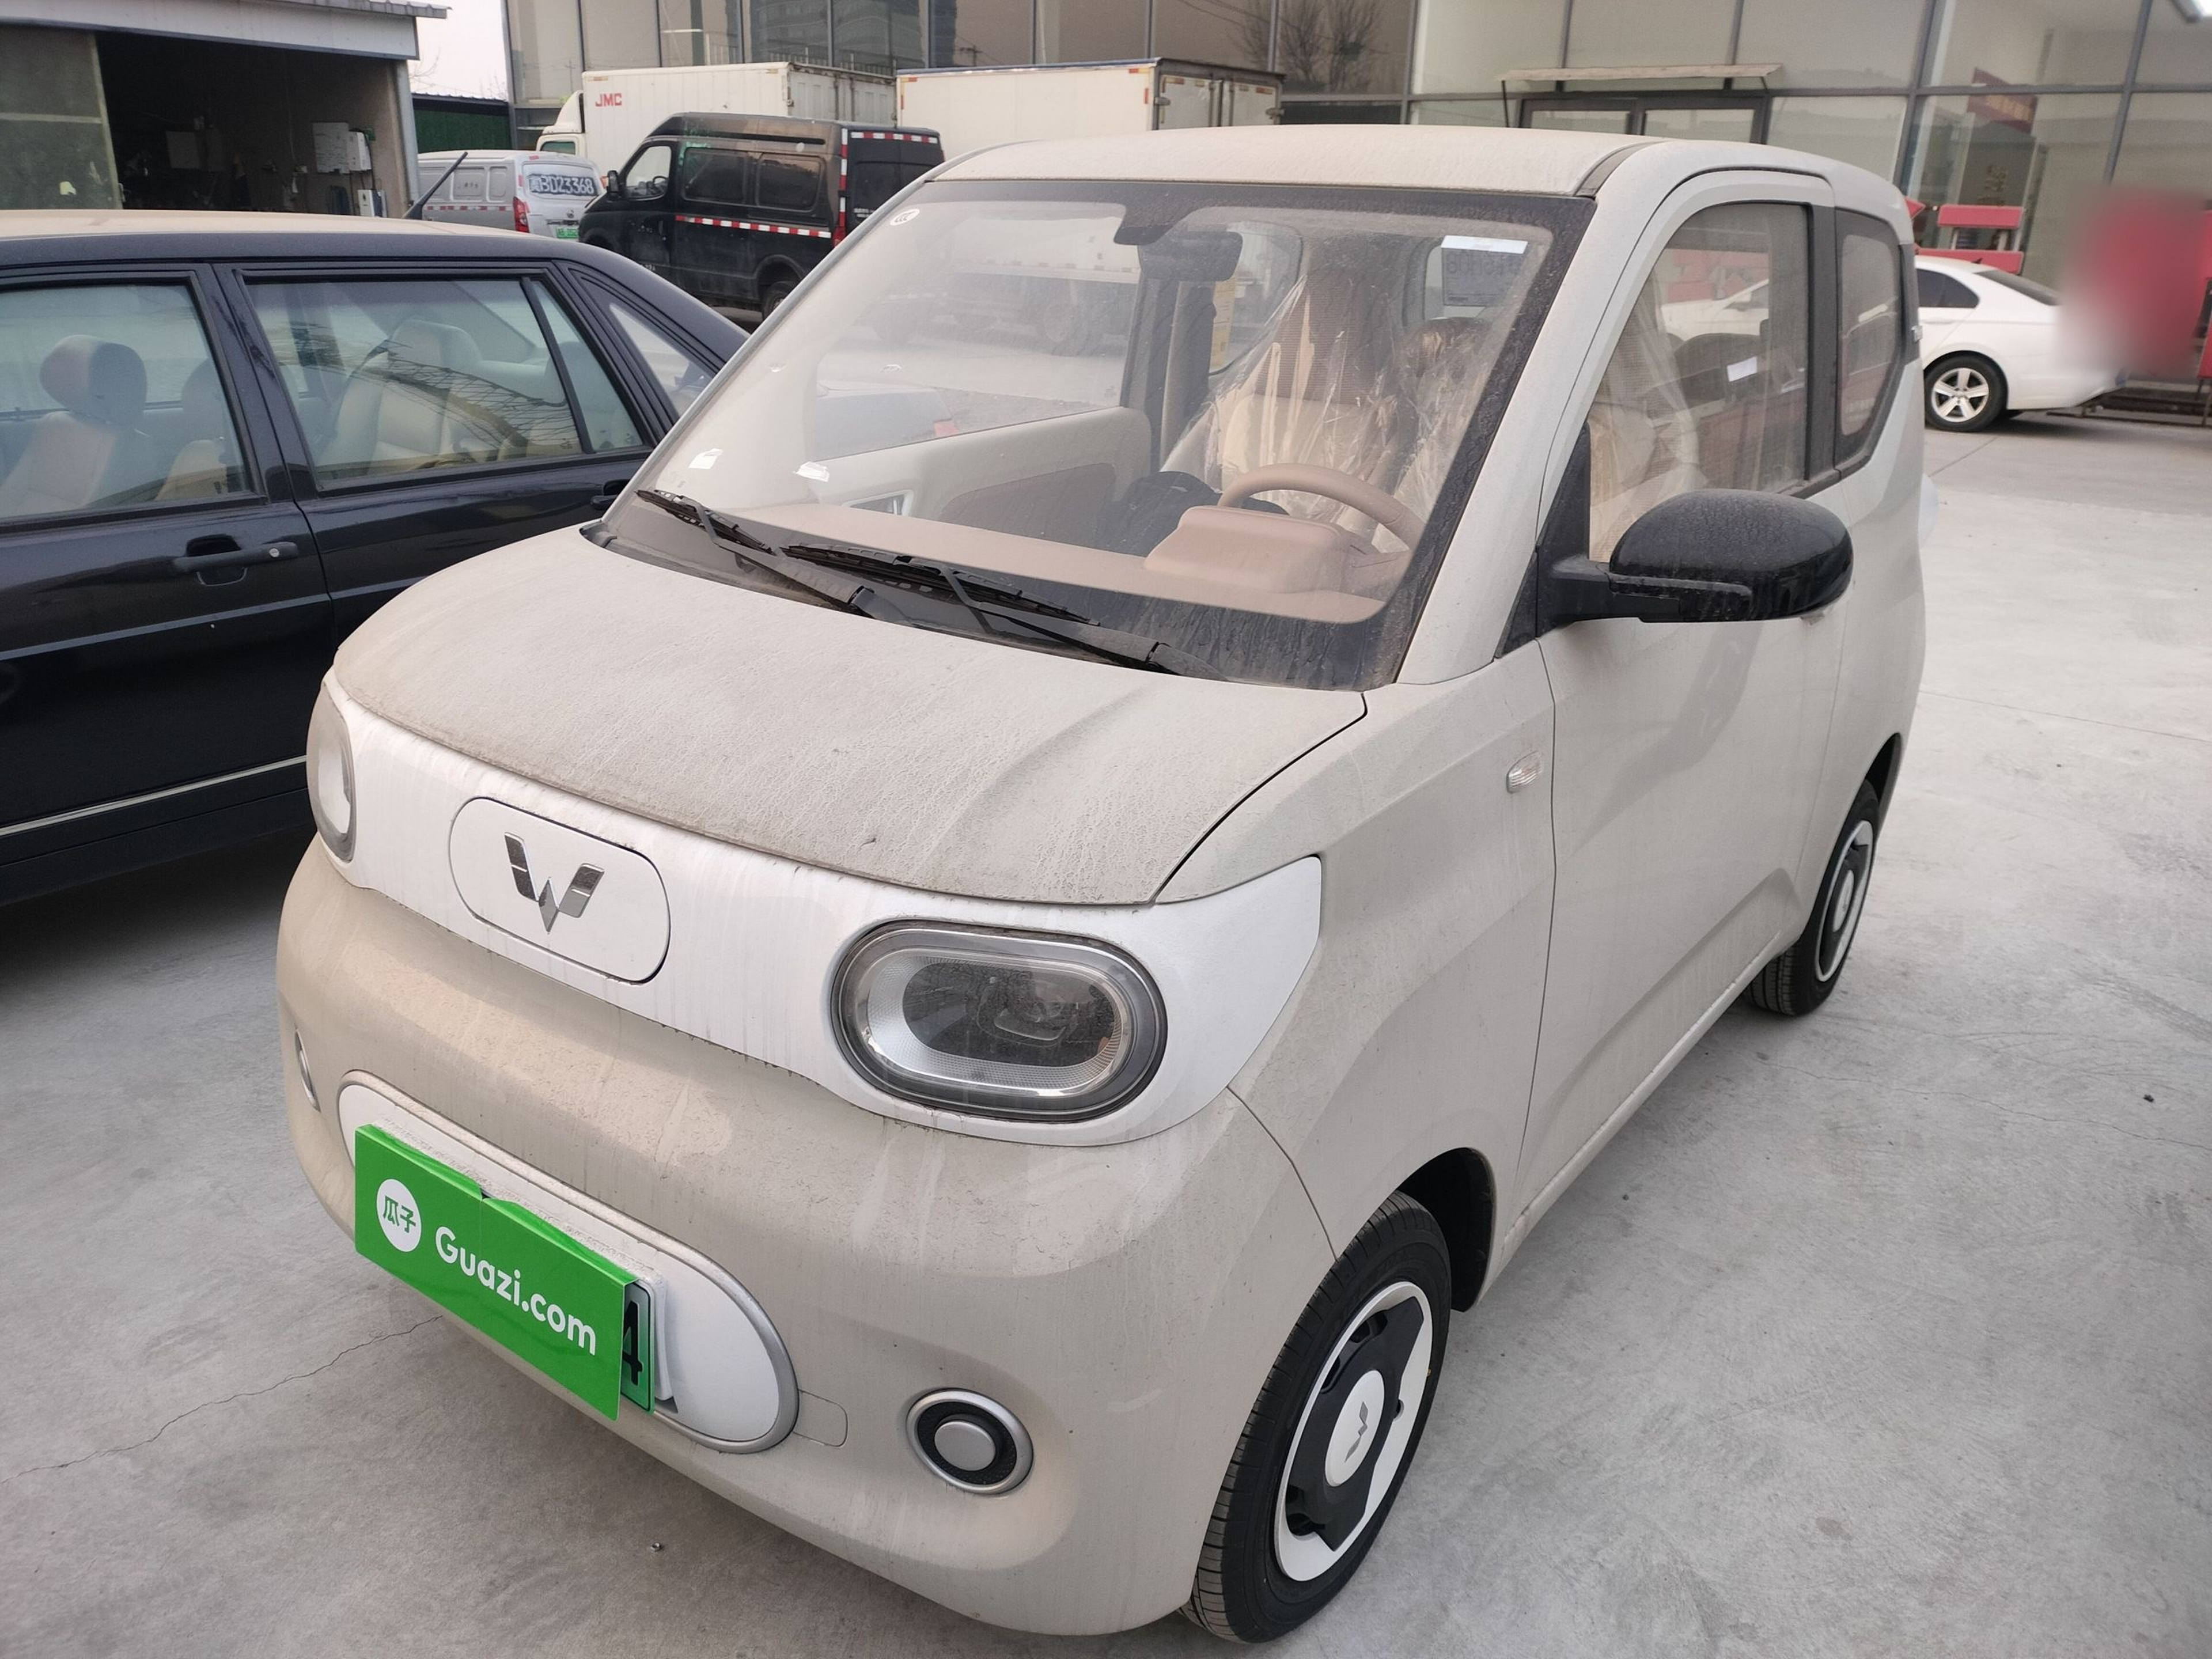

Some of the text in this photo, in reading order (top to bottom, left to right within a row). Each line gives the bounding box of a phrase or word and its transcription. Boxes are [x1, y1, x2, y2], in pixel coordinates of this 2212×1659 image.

[595, 93, 622, 107] JMC
[383, 1195, 416, 1233] 瓜子
[435, 1226, 596, 1356] Guazi.com
